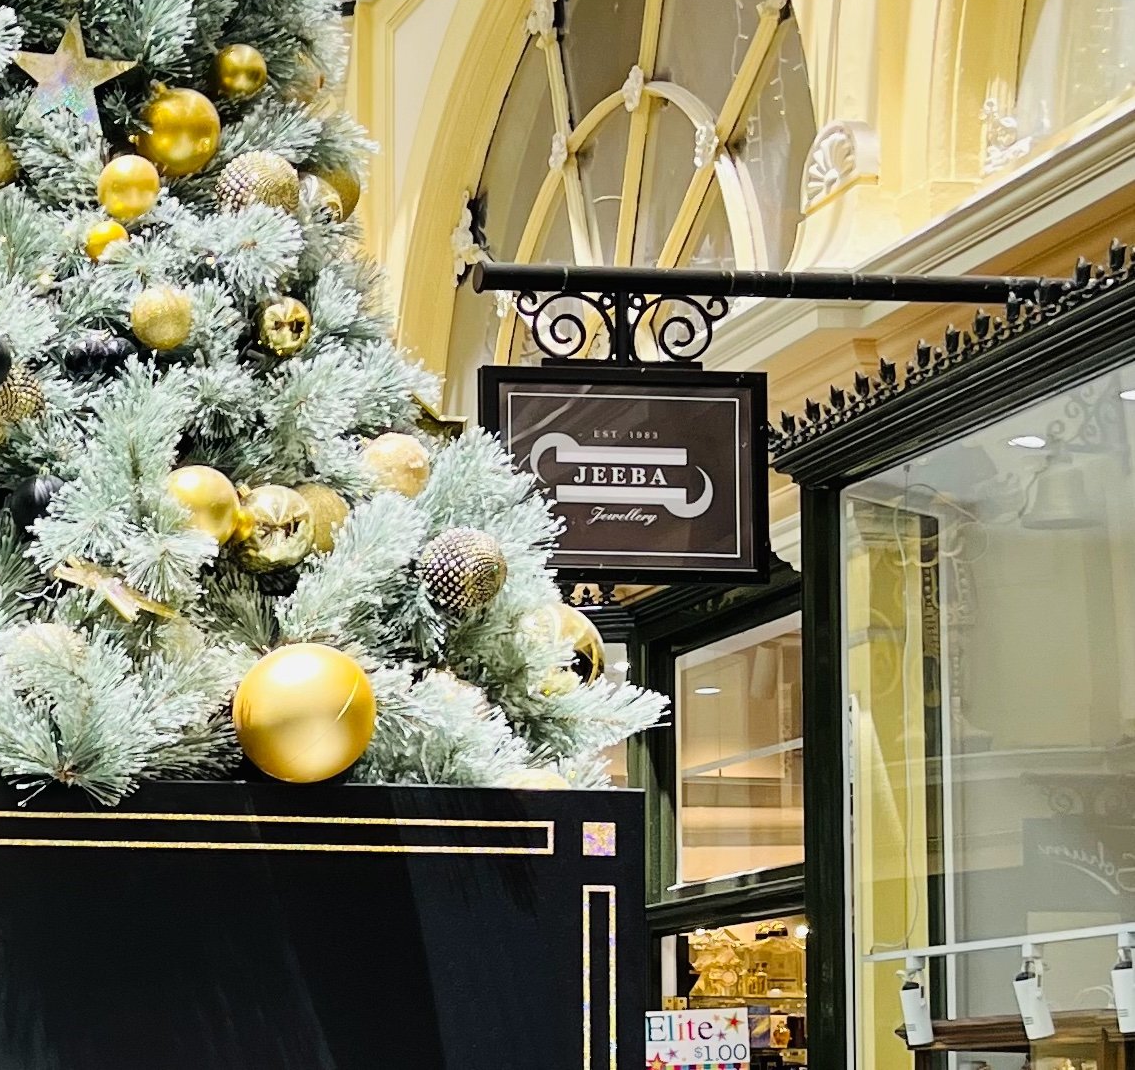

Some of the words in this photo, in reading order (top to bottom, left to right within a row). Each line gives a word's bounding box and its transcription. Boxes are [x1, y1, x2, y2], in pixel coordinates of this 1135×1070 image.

[573, 466, 668, 486] JEEBA
[586, 506, 658, 526] Jewellery
[645, 1014, 713, 1042] Elite
[694, 1043, 747, 1062] $1.00
